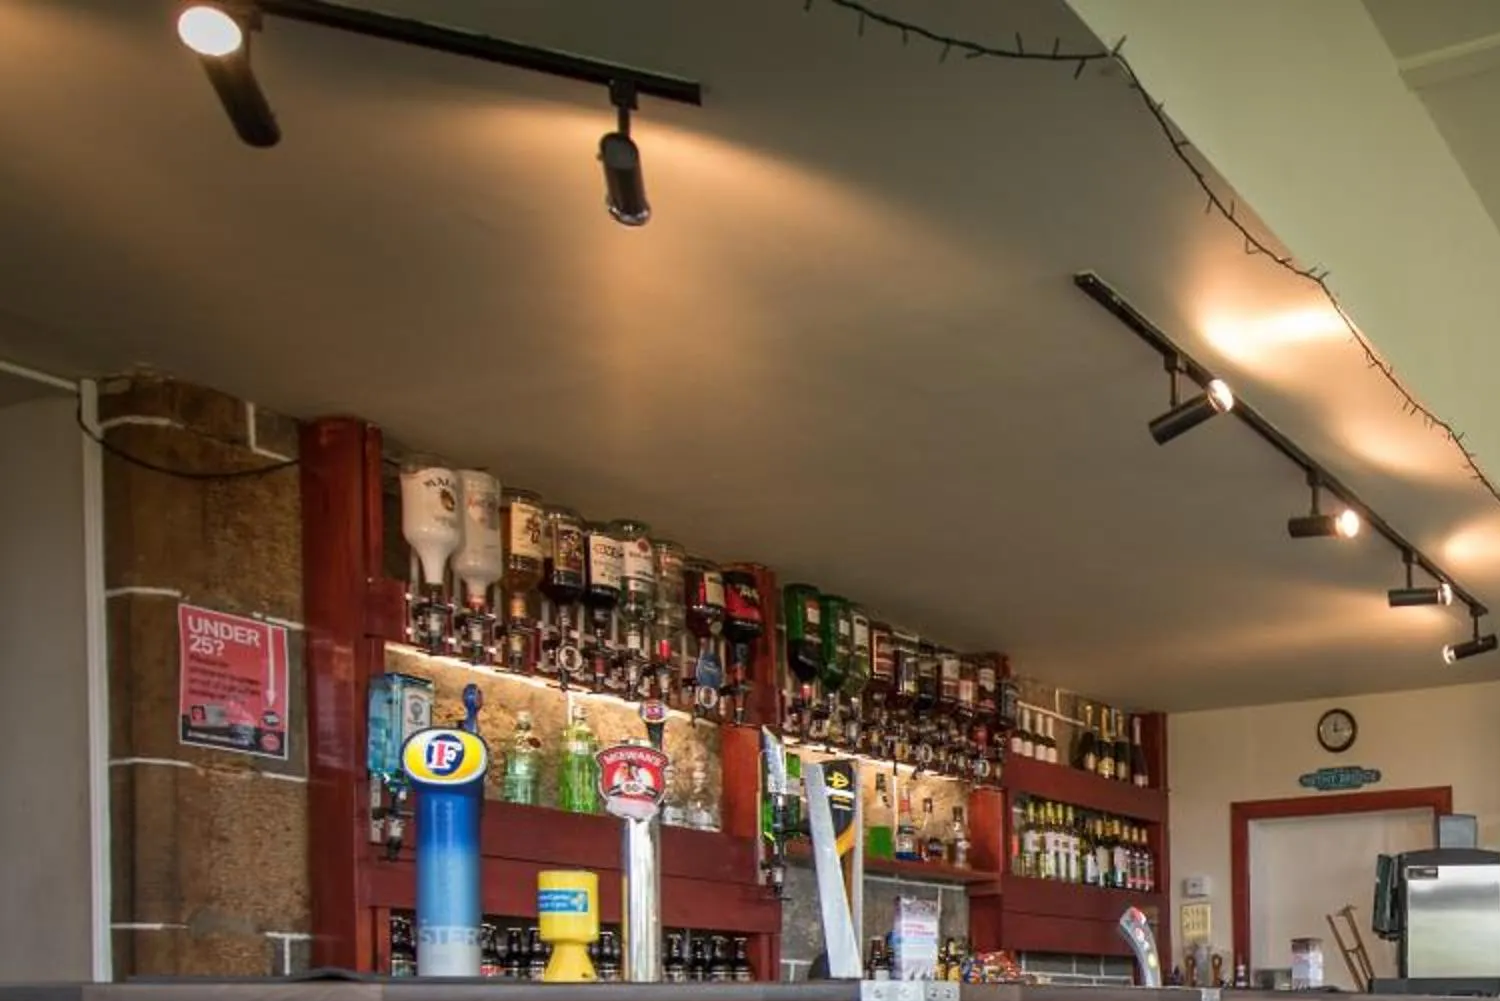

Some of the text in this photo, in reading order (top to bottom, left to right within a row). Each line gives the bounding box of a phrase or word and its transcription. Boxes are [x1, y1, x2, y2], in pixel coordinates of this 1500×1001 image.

[188, 615, 261, 648] UNDER
[190, 634, 225, 657] 25?
[427, 740, 463, 769] F
